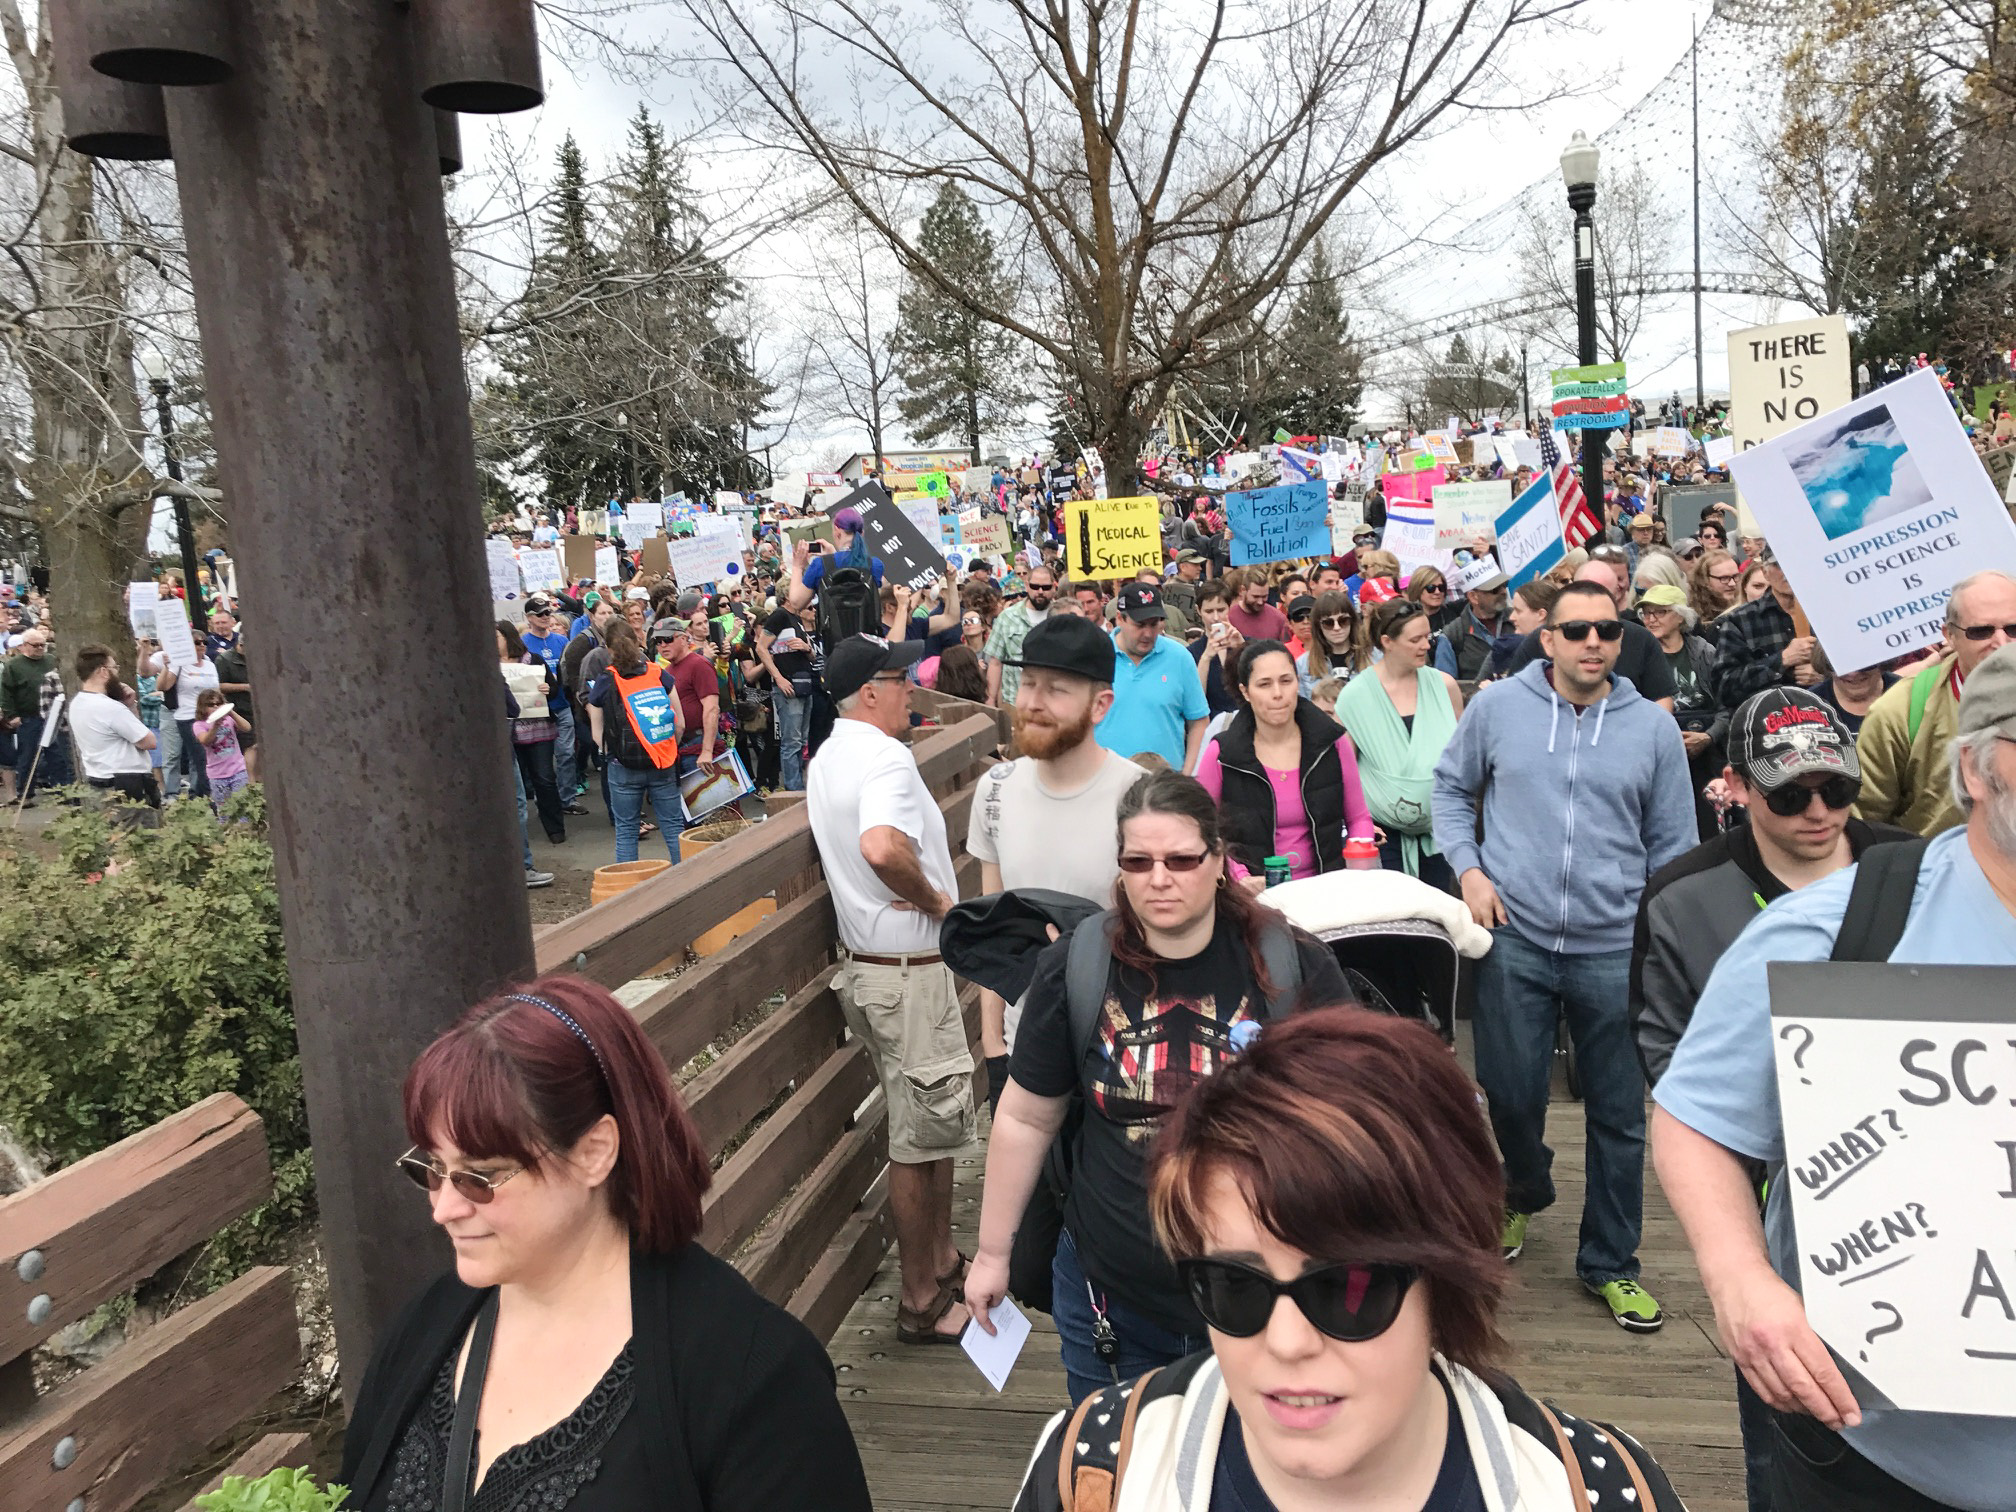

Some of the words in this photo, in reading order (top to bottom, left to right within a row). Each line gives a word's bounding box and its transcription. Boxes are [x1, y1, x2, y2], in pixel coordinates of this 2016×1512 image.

[1749, 332, 1827, 362] THERE
[1780, 364, 1804, 390] IS
[1555, 385, 1592, 398] SPOKANE
[1593, 383, 1616, 393] FALLS
[1562, 401, 1608, 412] PAVILION
[1763, 396, 1819, 423] NO
[1557, 414, 1617, 428] RESTROOMS
[1660, 445, 1684, 453] MATTER
[853, 497, 877, 515] NIAL
[1094, 502, 1121, 512] ALIVE
[1125, 503, 1139, 511] DUE
[1252, 491, 1299, 519] Fossils
[871, 519, 883, 533] IS
[960, 511, 976, 523] NCE
[1260, 518, 1288, 537] Fuel
[964, 523, 1000, 538] SCIENCE
[970, 535, 993, 544] DENIAL
[1097, 526, 1150, 541] MEDICAL
[1501, 525, 1520, 552] SAVE
[1824, 506, 1959, 569] SUPPRESSION
[882, 535, 903, 554] NOT
[979, 542, 1004, 553] EADLY
[1247, 536, 1308, 560] Pollution
[1512, 520, 1549, 568] SANITY
[904, 556, 916, 569] A
[1096, 548, 1161, 570] SCIENCE
[1845, 565, 1872, 584] OF
[1874, 532, 1960, 574] SCIENCE
[908, 565, 941, 591] POLICY
[1464, 561, 1496, 582] Mother
[1902, 573, 1923, 591] IS
[1857, 588, 1952, 633] SUPPRESS
[1885, 629, 1912, 648] OF
[1914, 616, 1947, 638] TR
[1779, 1023, 1815, 1086] ?
[1898, 1038, 2016, 1107] SC
[1794, 1108, 1910, 1190] WHAT?
[1810, 1201, 1939, 1277] WHEN?
[1961, 1247, 2016, 1322] A
[1859, 1300, 1904, 1363] ?
